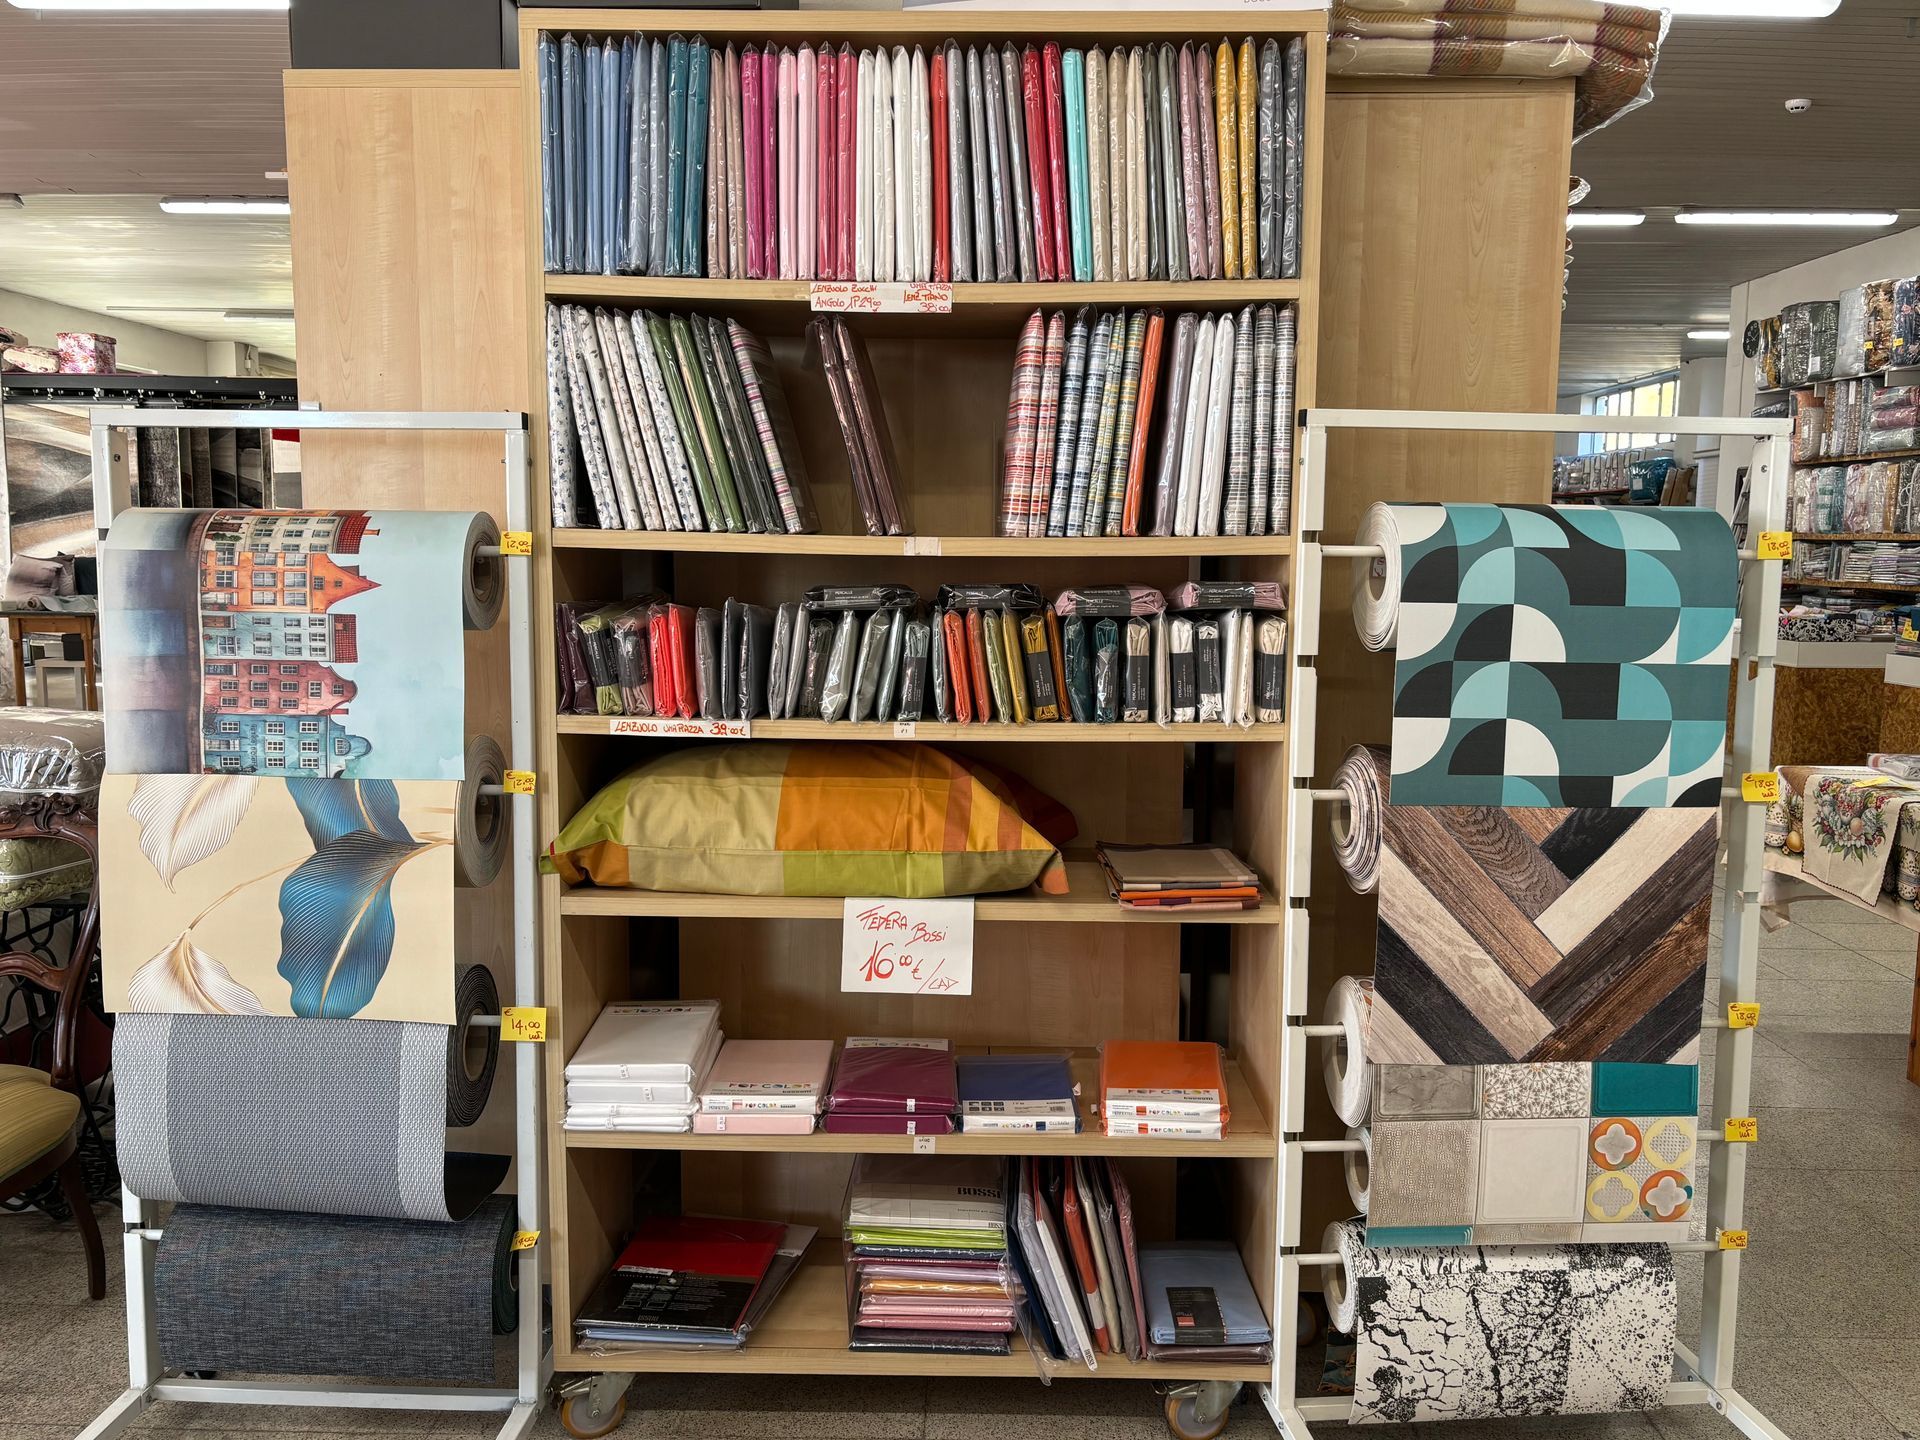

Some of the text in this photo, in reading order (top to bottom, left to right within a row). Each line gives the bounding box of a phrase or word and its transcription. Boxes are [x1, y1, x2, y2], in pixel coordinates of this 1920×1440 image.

[815, 296, 845, 308] ANGOLO
[856, 905, 908, 931] FEDERA
[504, 1008, 513, 1017] €
[512, 1018, 541, 1036] 14,00
[1738, 1120, 1756, 1129] 16,00
[957, 1187, 1002, 1199] BOSSI
